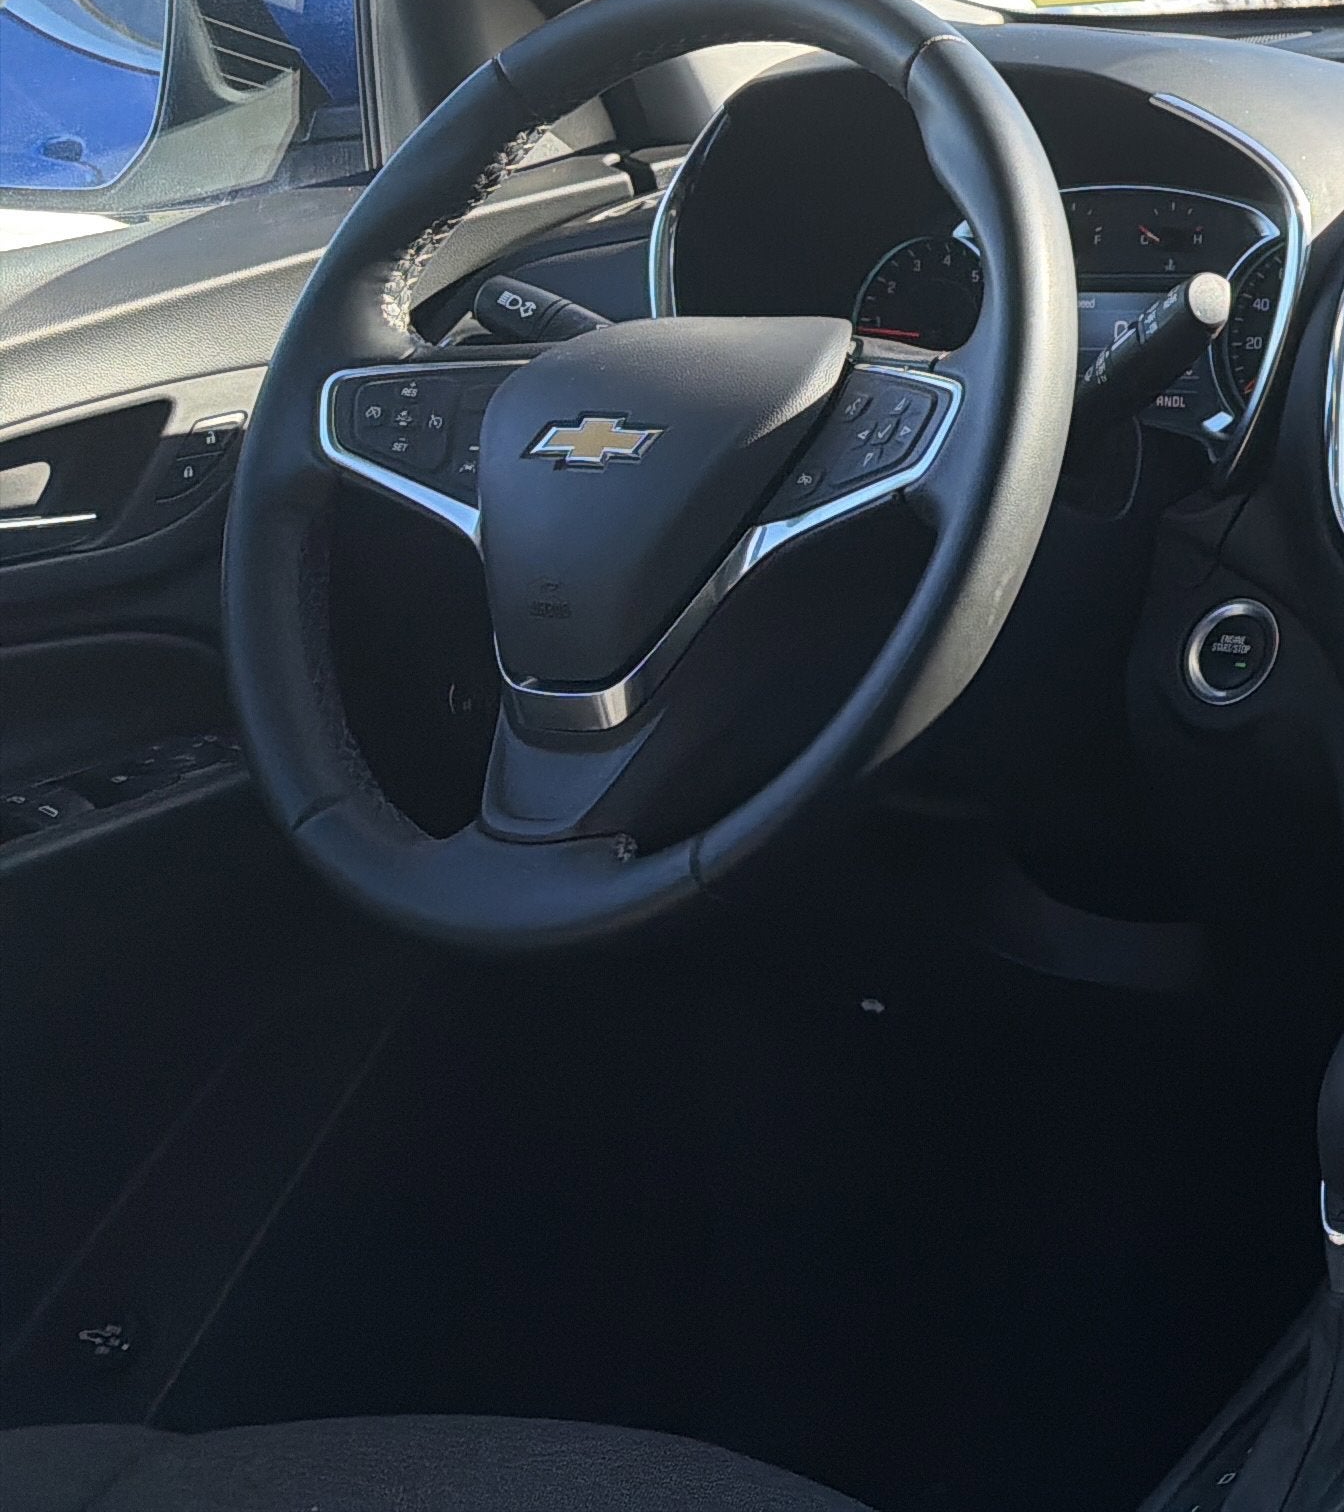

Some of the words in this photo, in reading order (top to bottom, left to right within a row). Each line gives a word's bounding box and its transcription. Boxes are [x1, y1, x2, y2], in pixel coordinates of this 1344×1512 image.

[913, 259, 921, 272] 3
[943, 254, 951, 266] 4
[971, 270, 979, 282] 5
[888, 281, 896, 294] 2
[1252, 298, 1270, 311] 40
[1246, 337, 1262, 349] 20
[392, 442, 409, 452] SET
